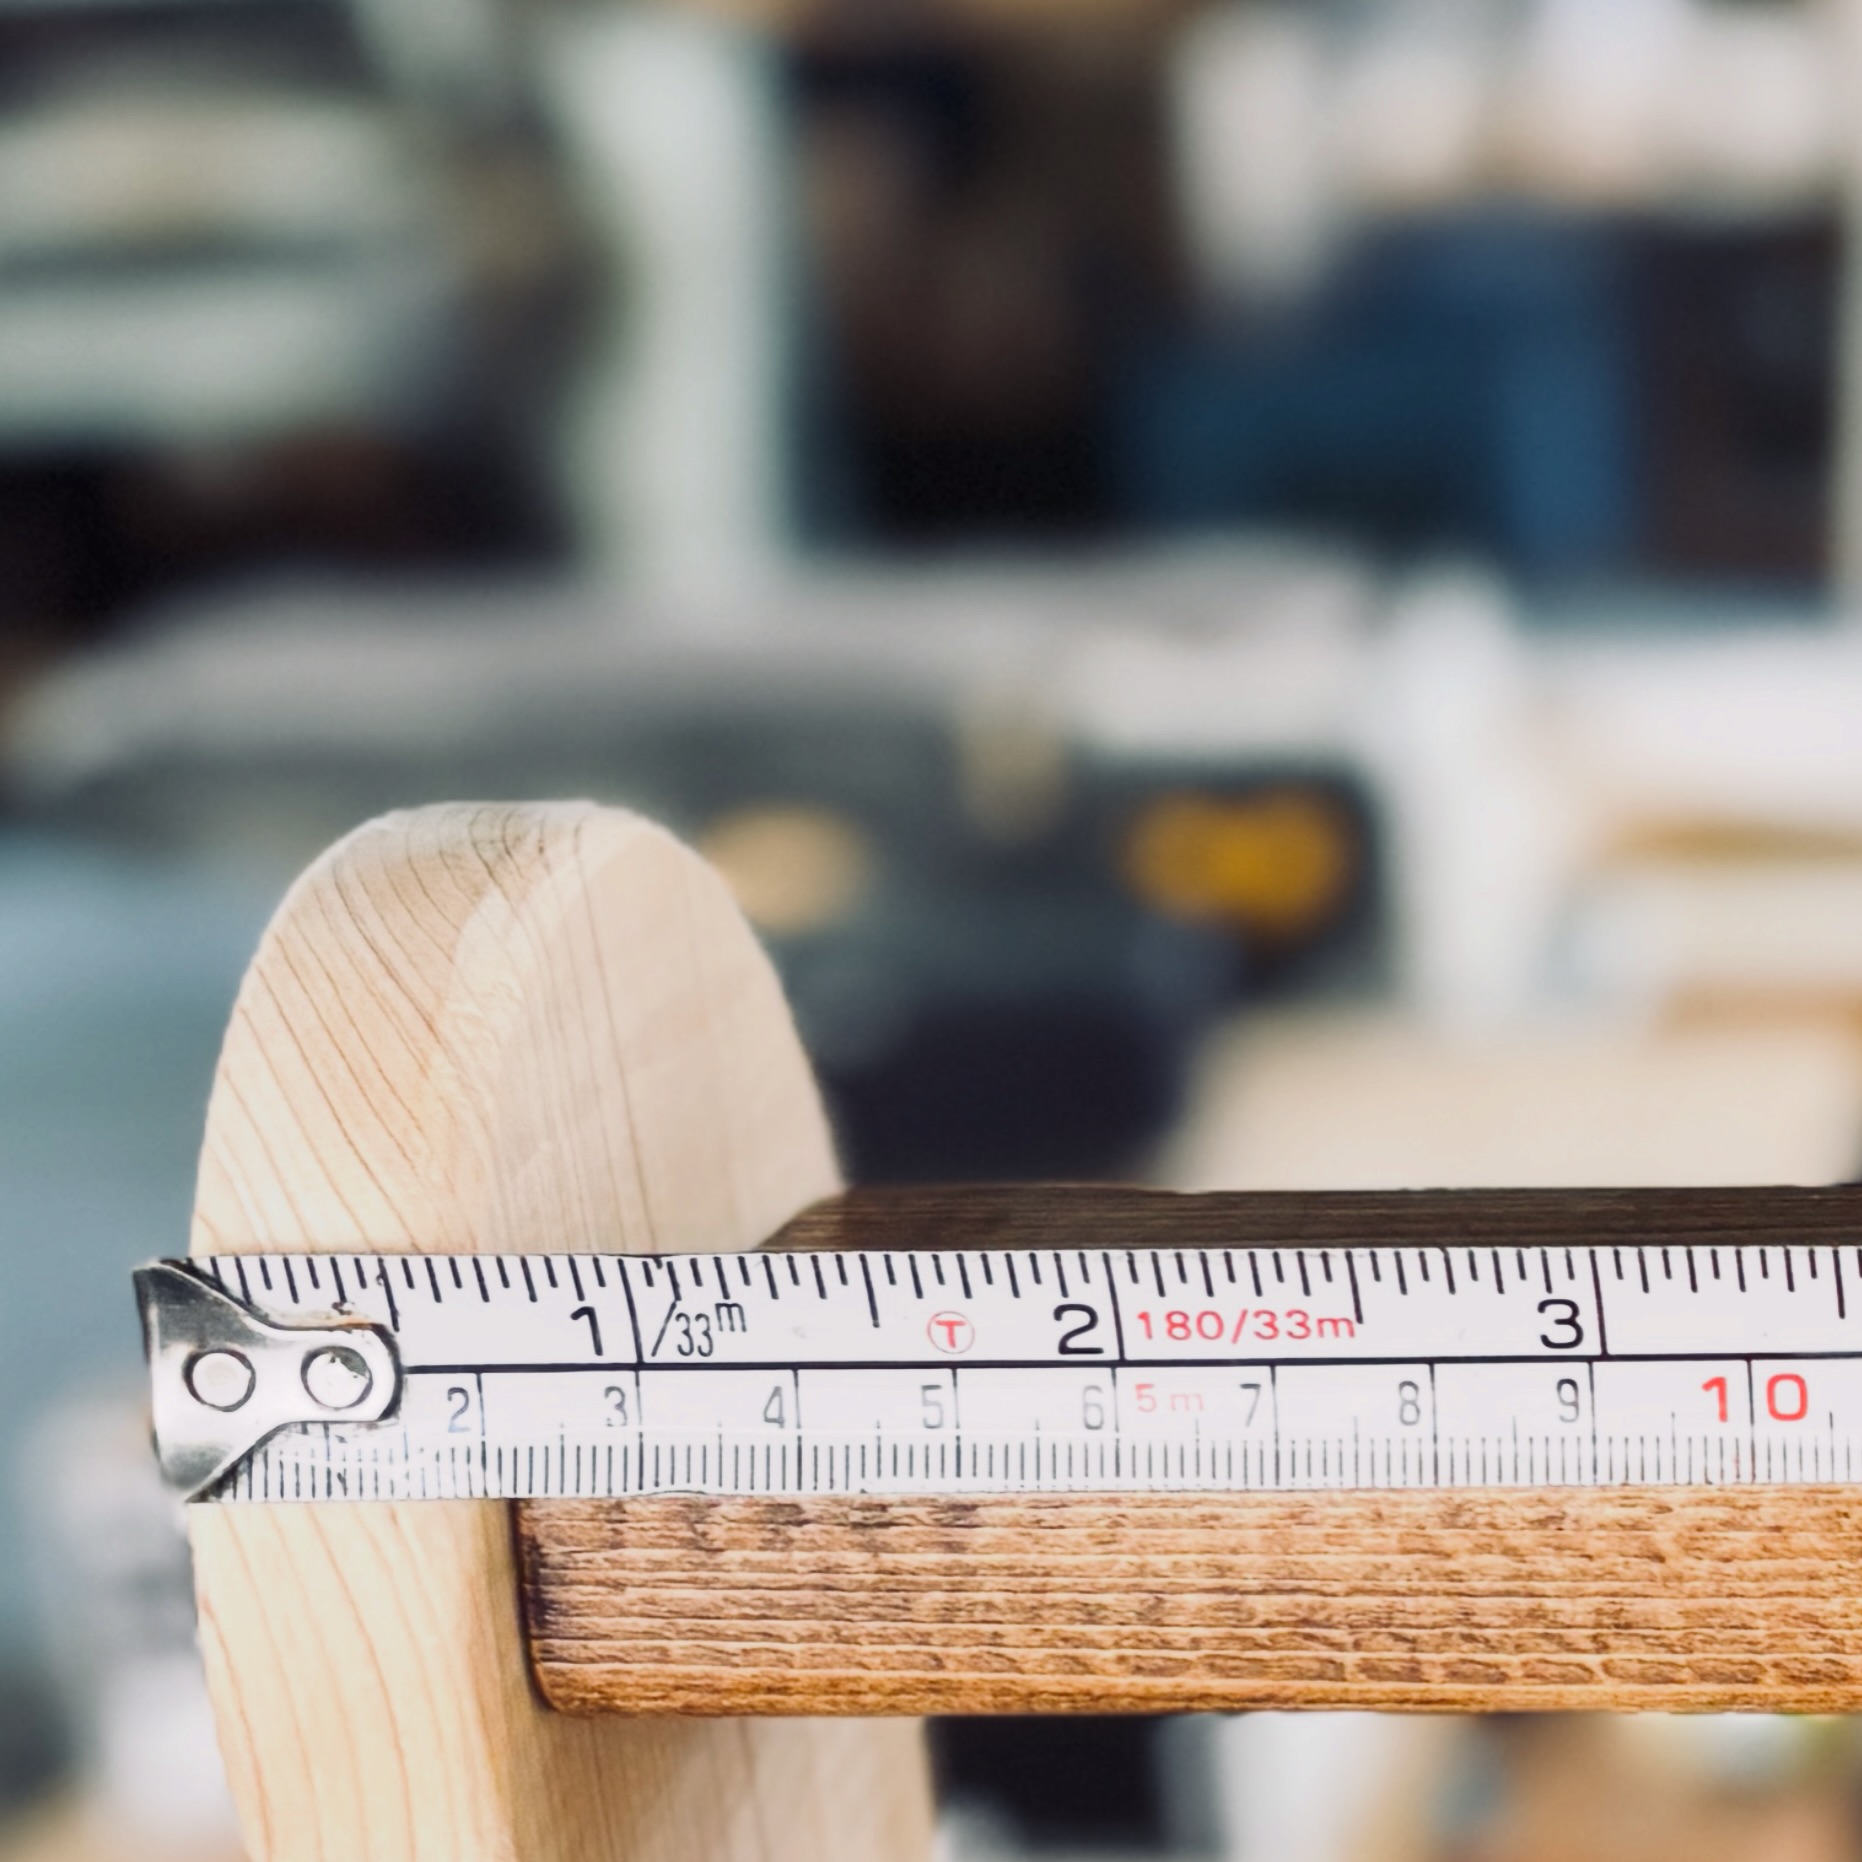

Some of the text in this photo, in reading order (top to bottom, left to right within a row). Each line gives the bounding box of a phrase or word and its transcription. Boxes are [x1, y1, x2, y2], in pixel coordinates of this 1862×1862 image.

[569, 1305, 604, 1357] 1
[1053, 1303, 1105, 1355] 2
[1138, 1308, 1356, 1341] 180/33m
[1537, 1299, 1585, 1349] 3
[447, 1387, 472, 1433] 2
[604, 1386, 627, 1428] 3
[763, 1385, 786, 1429] 4
[920, 1384, 944, 1429] 5
[1082, 1385, 1105, 1430] 6
[1239, 1383, 1262, 1427] 7
[1398, 1380, 1421, 1426] 8
[1556, 1378, 1580, 1423] 9
[1701, 1373, 1809, 1422] 10
